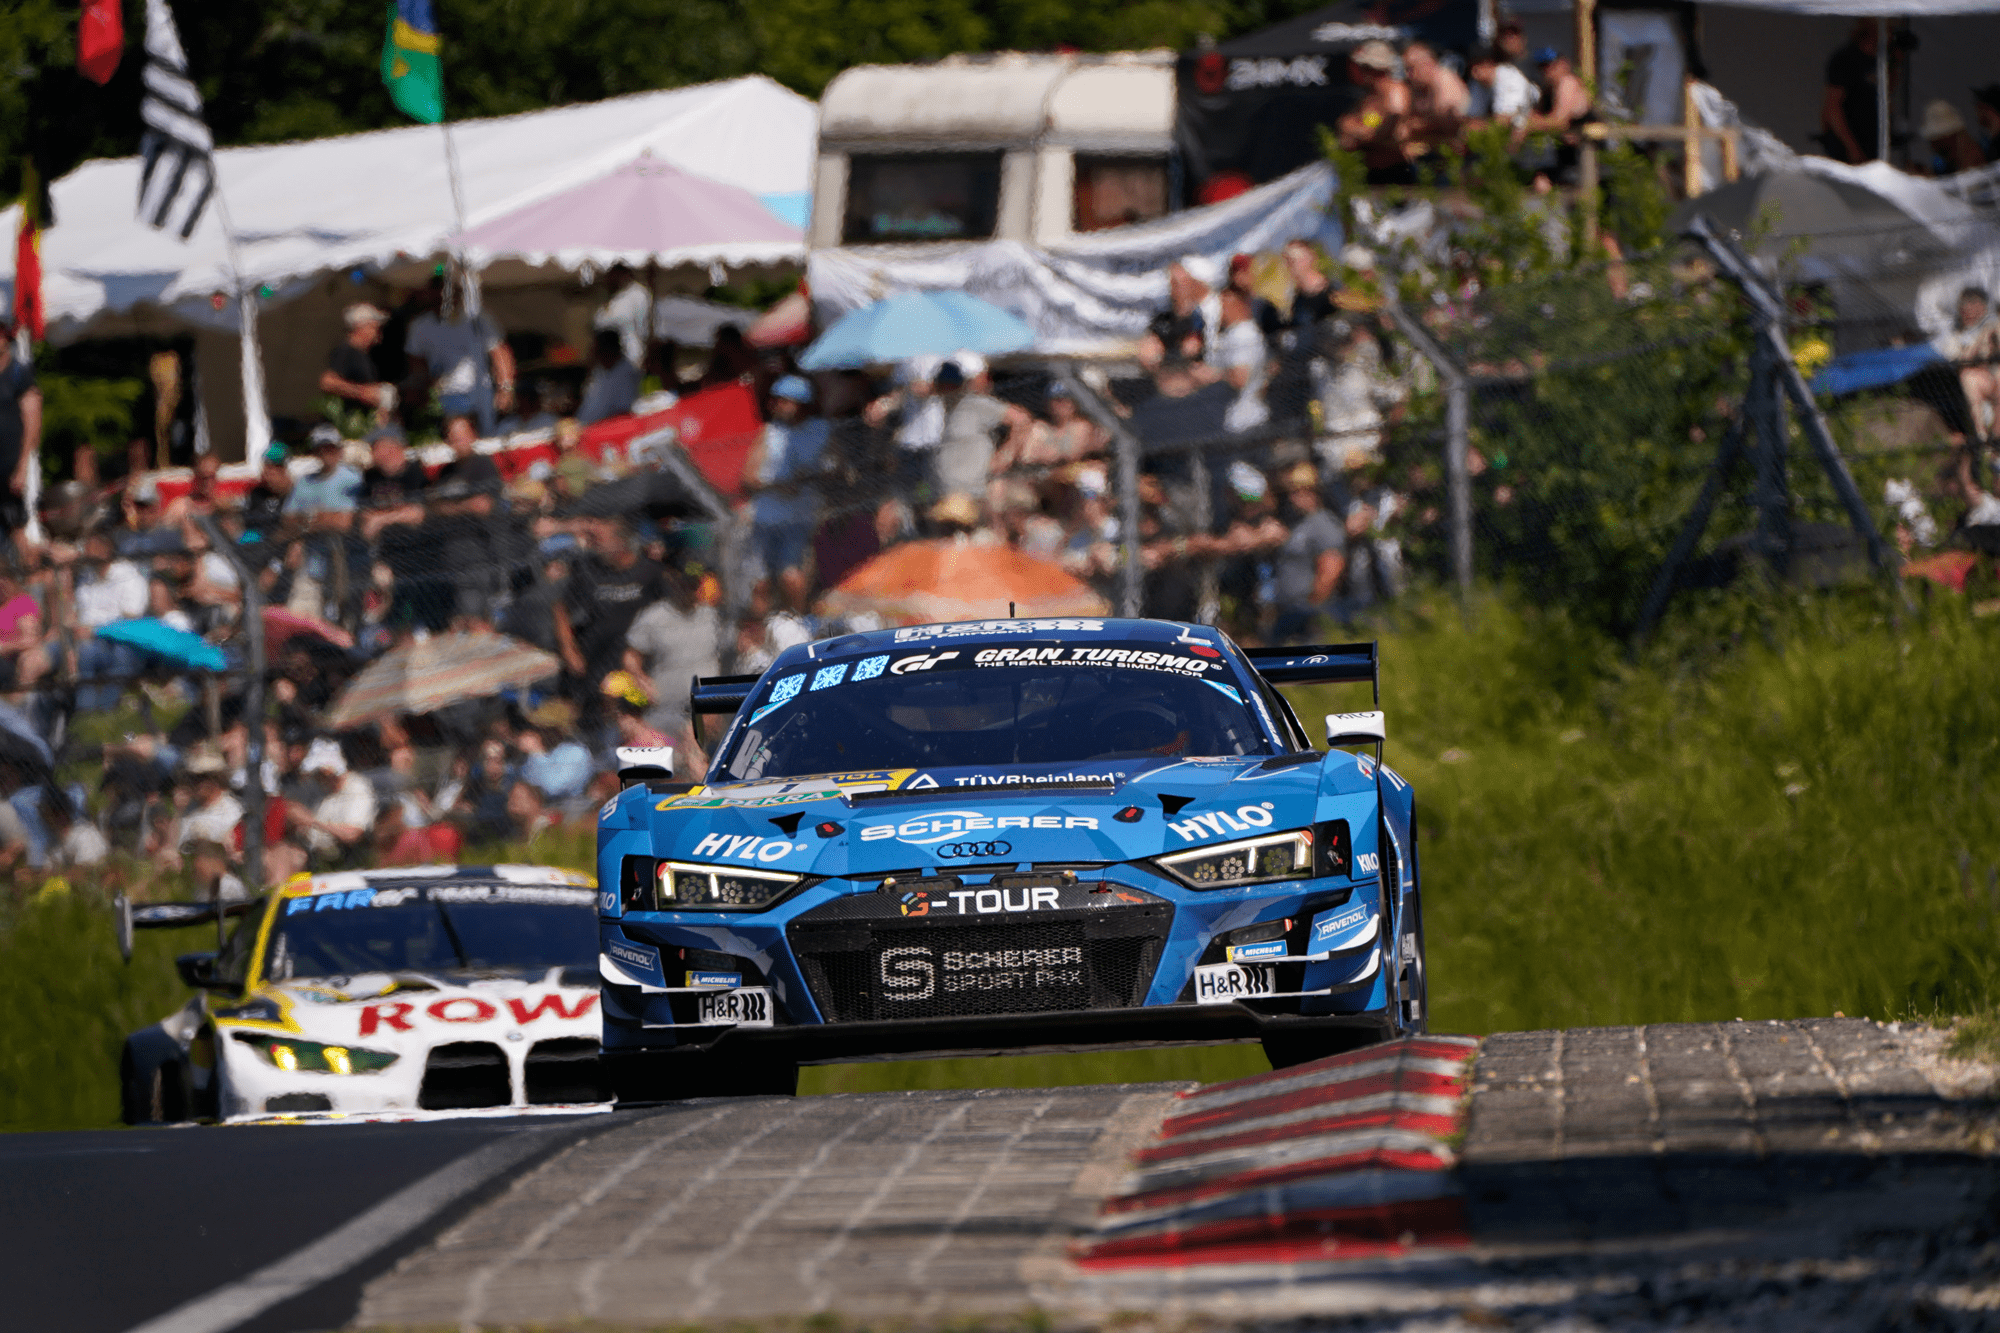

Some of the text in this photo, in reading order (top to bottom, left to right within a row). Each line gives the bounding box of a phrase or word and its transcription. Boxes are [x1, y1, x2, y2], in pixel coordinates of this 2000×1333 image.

[974, 648, 1209, 672] GRAN TURISMO
[1117, 662, 1203, 678] SIMULATOR
[722, 792, 824, 806] DEKRA
[860, 815, 1099, 842] SCHERER
[1168, 805, 1274, 842] HYLO
[692, 833, 794, 862] HYLO
[901, 887, 1060, 917] G-TOUR
[1322, 911, 1364, 934] RAVENOL
[611, 945, 652, 967] RAVENOL
[943, 947, 1082, 971] SCHERER
[1245, 944, 1283, 956] MICHELIN
[701, 976, 737, 984] MICHELIN
[1200, 971, 1243, 997] H&R
[359, 993, 600, 1037] ROW
[702, 994, 739, 1018] H&R
